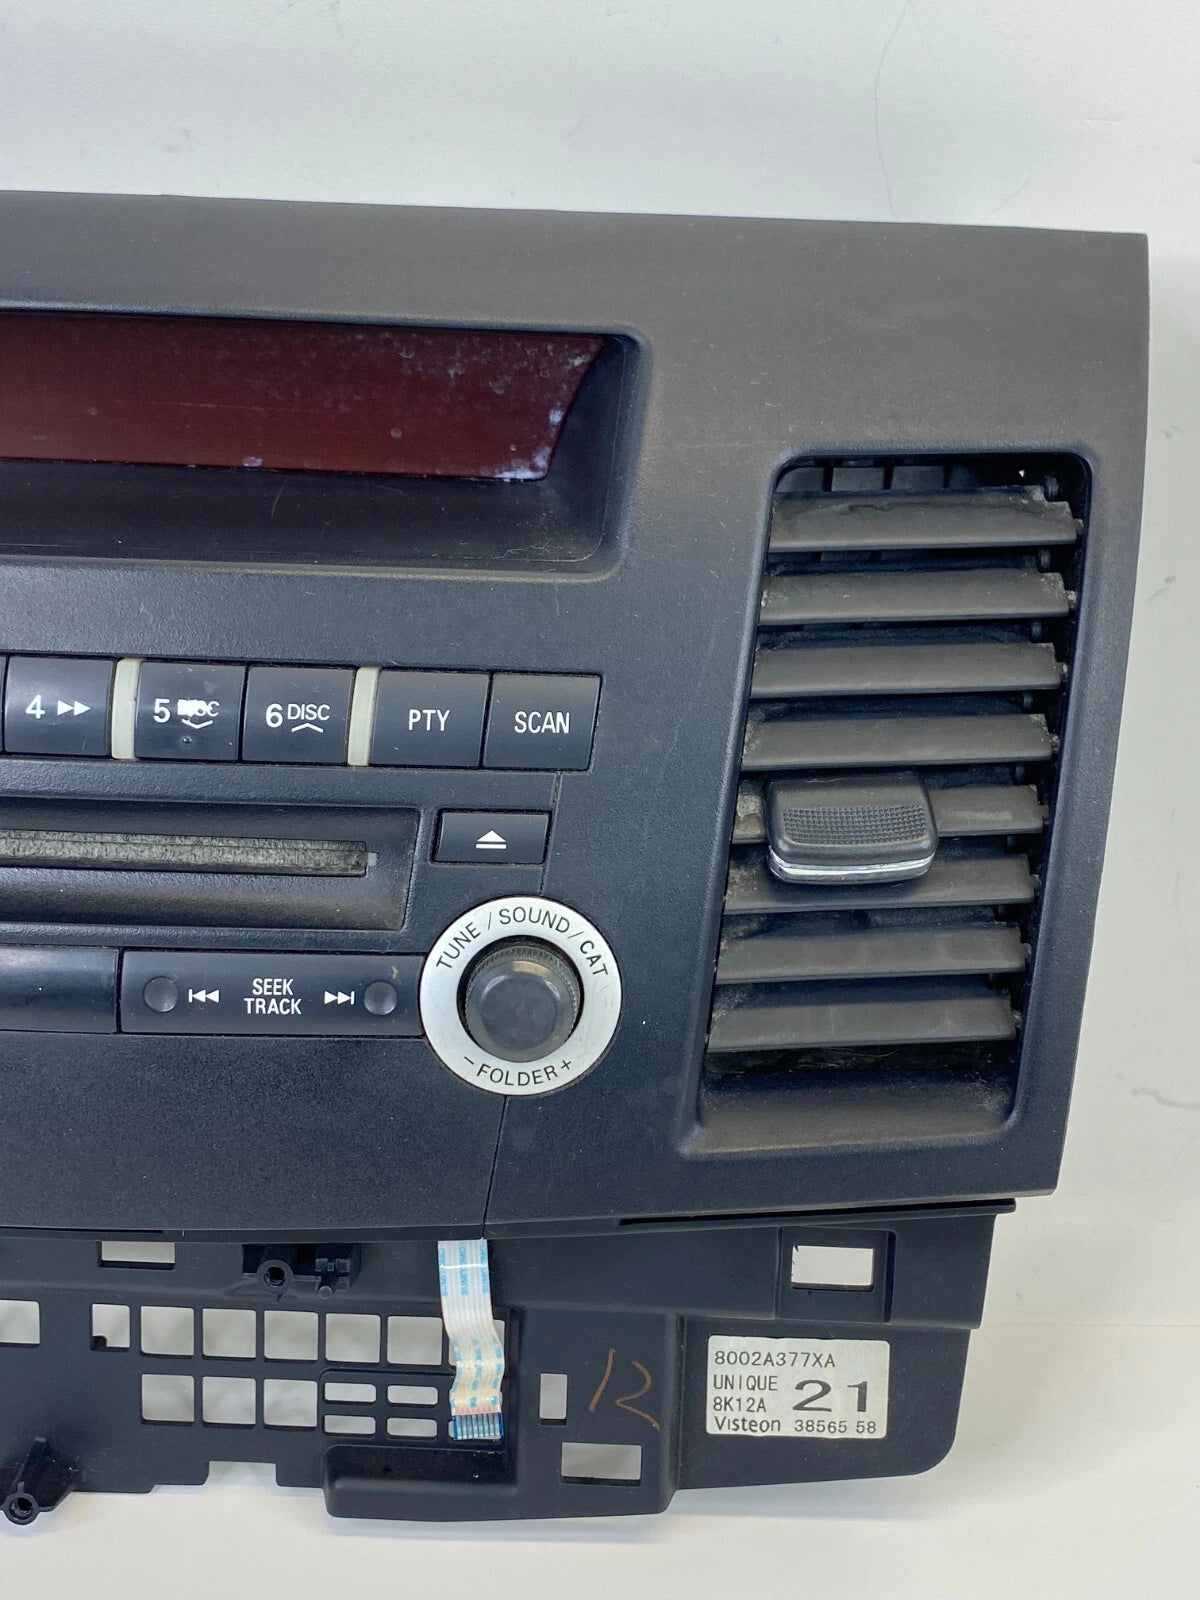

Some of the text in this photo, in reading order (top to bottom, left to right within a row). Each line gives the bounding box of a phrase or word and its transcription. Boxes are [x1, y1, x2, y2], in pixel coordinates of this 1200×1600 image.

[25, 694, 46, 720] 4
[153, 698, 171, 723] 5
[265, 703, 331, 728] 6 DISC
[408, 709, 451, 732] PTY
[514, 711, 570, 734] SCAN
[579, 940, 609, 977] CAT
[252, 977, 294, 996] SEEK
[244, 998, 302, 1015] TRACK
[476, 1062, 558, 1087] FOLDER
[714, 1350, 836, 1368] 8002A377XA
[713, 1374, 779, 1392] UNIQUE
[712, 1397, 767, 1413] 8K12A
[714, 1416, 877, 1434] Visteon 38565 58
